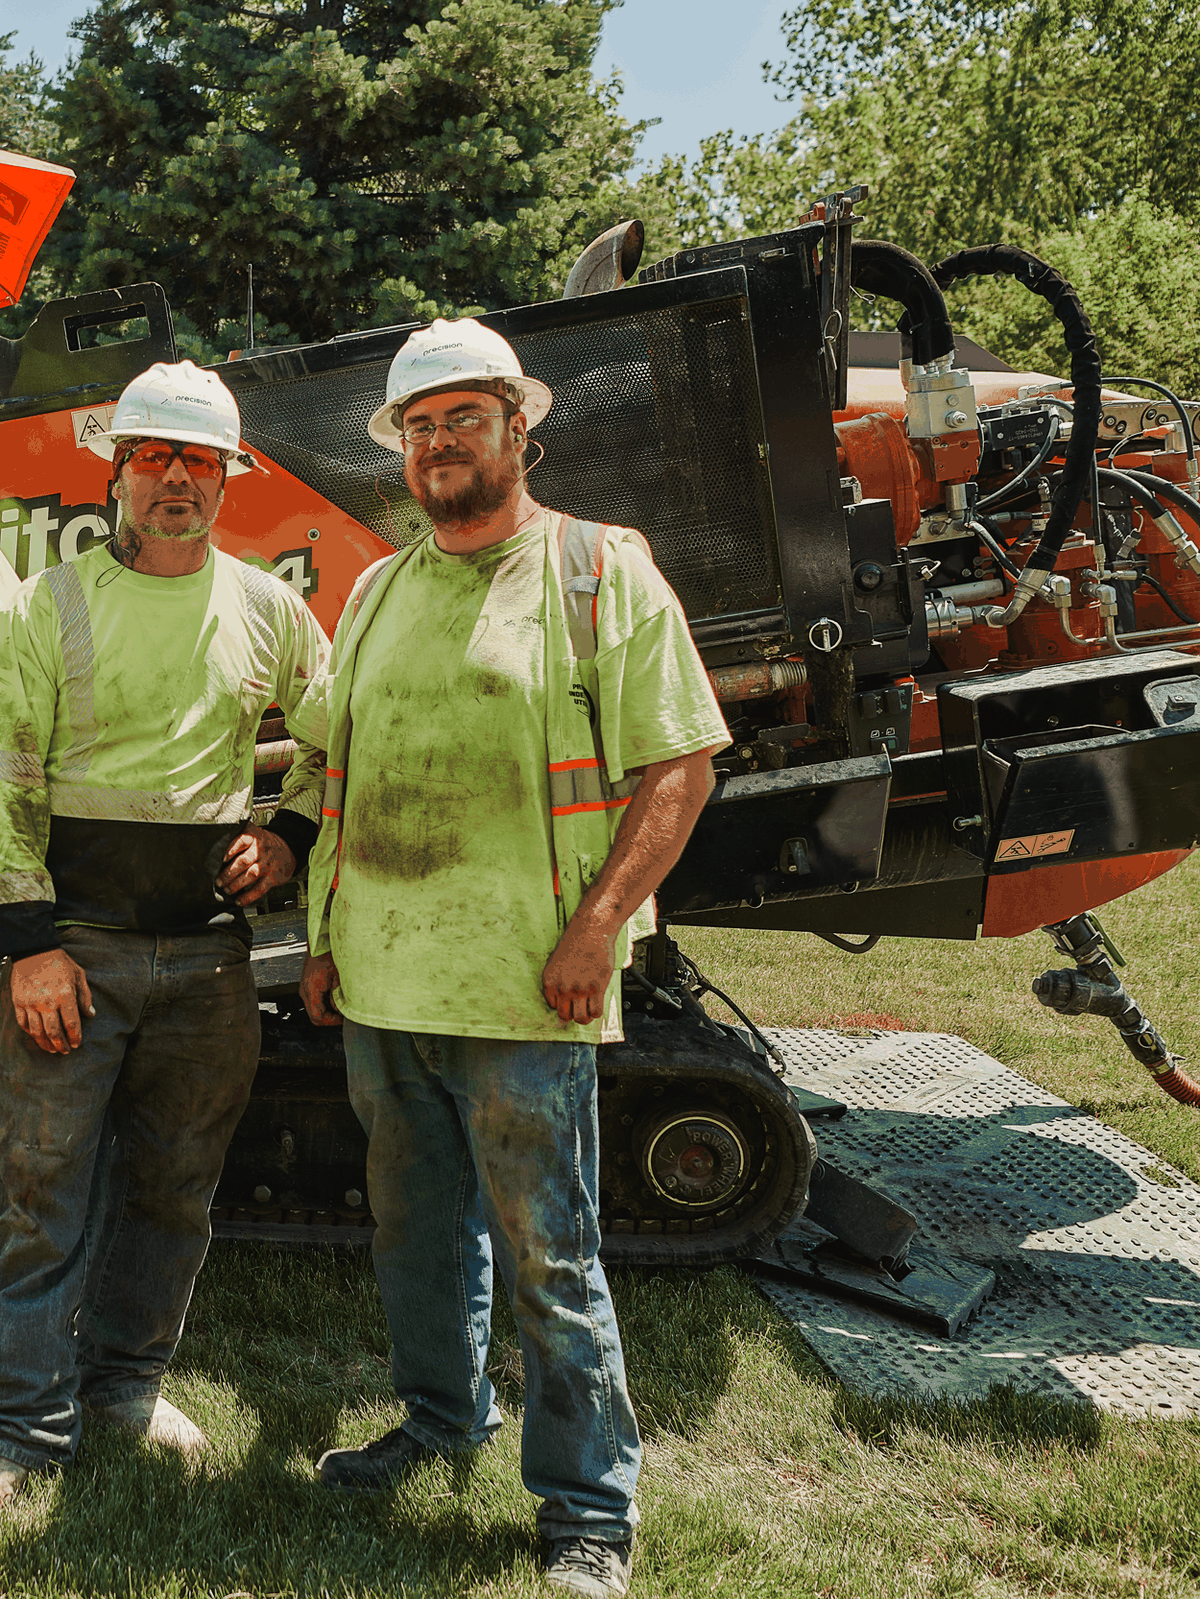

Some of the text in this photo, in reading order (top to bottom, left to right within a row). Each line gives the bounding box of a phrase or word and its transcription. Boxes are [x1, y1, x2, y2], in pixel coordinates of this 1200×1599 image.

[422, 342, 463, 357] precision
[175, 395, 212, 407] precision
[693, 1131, 735, 1198] POWER WHEEL
